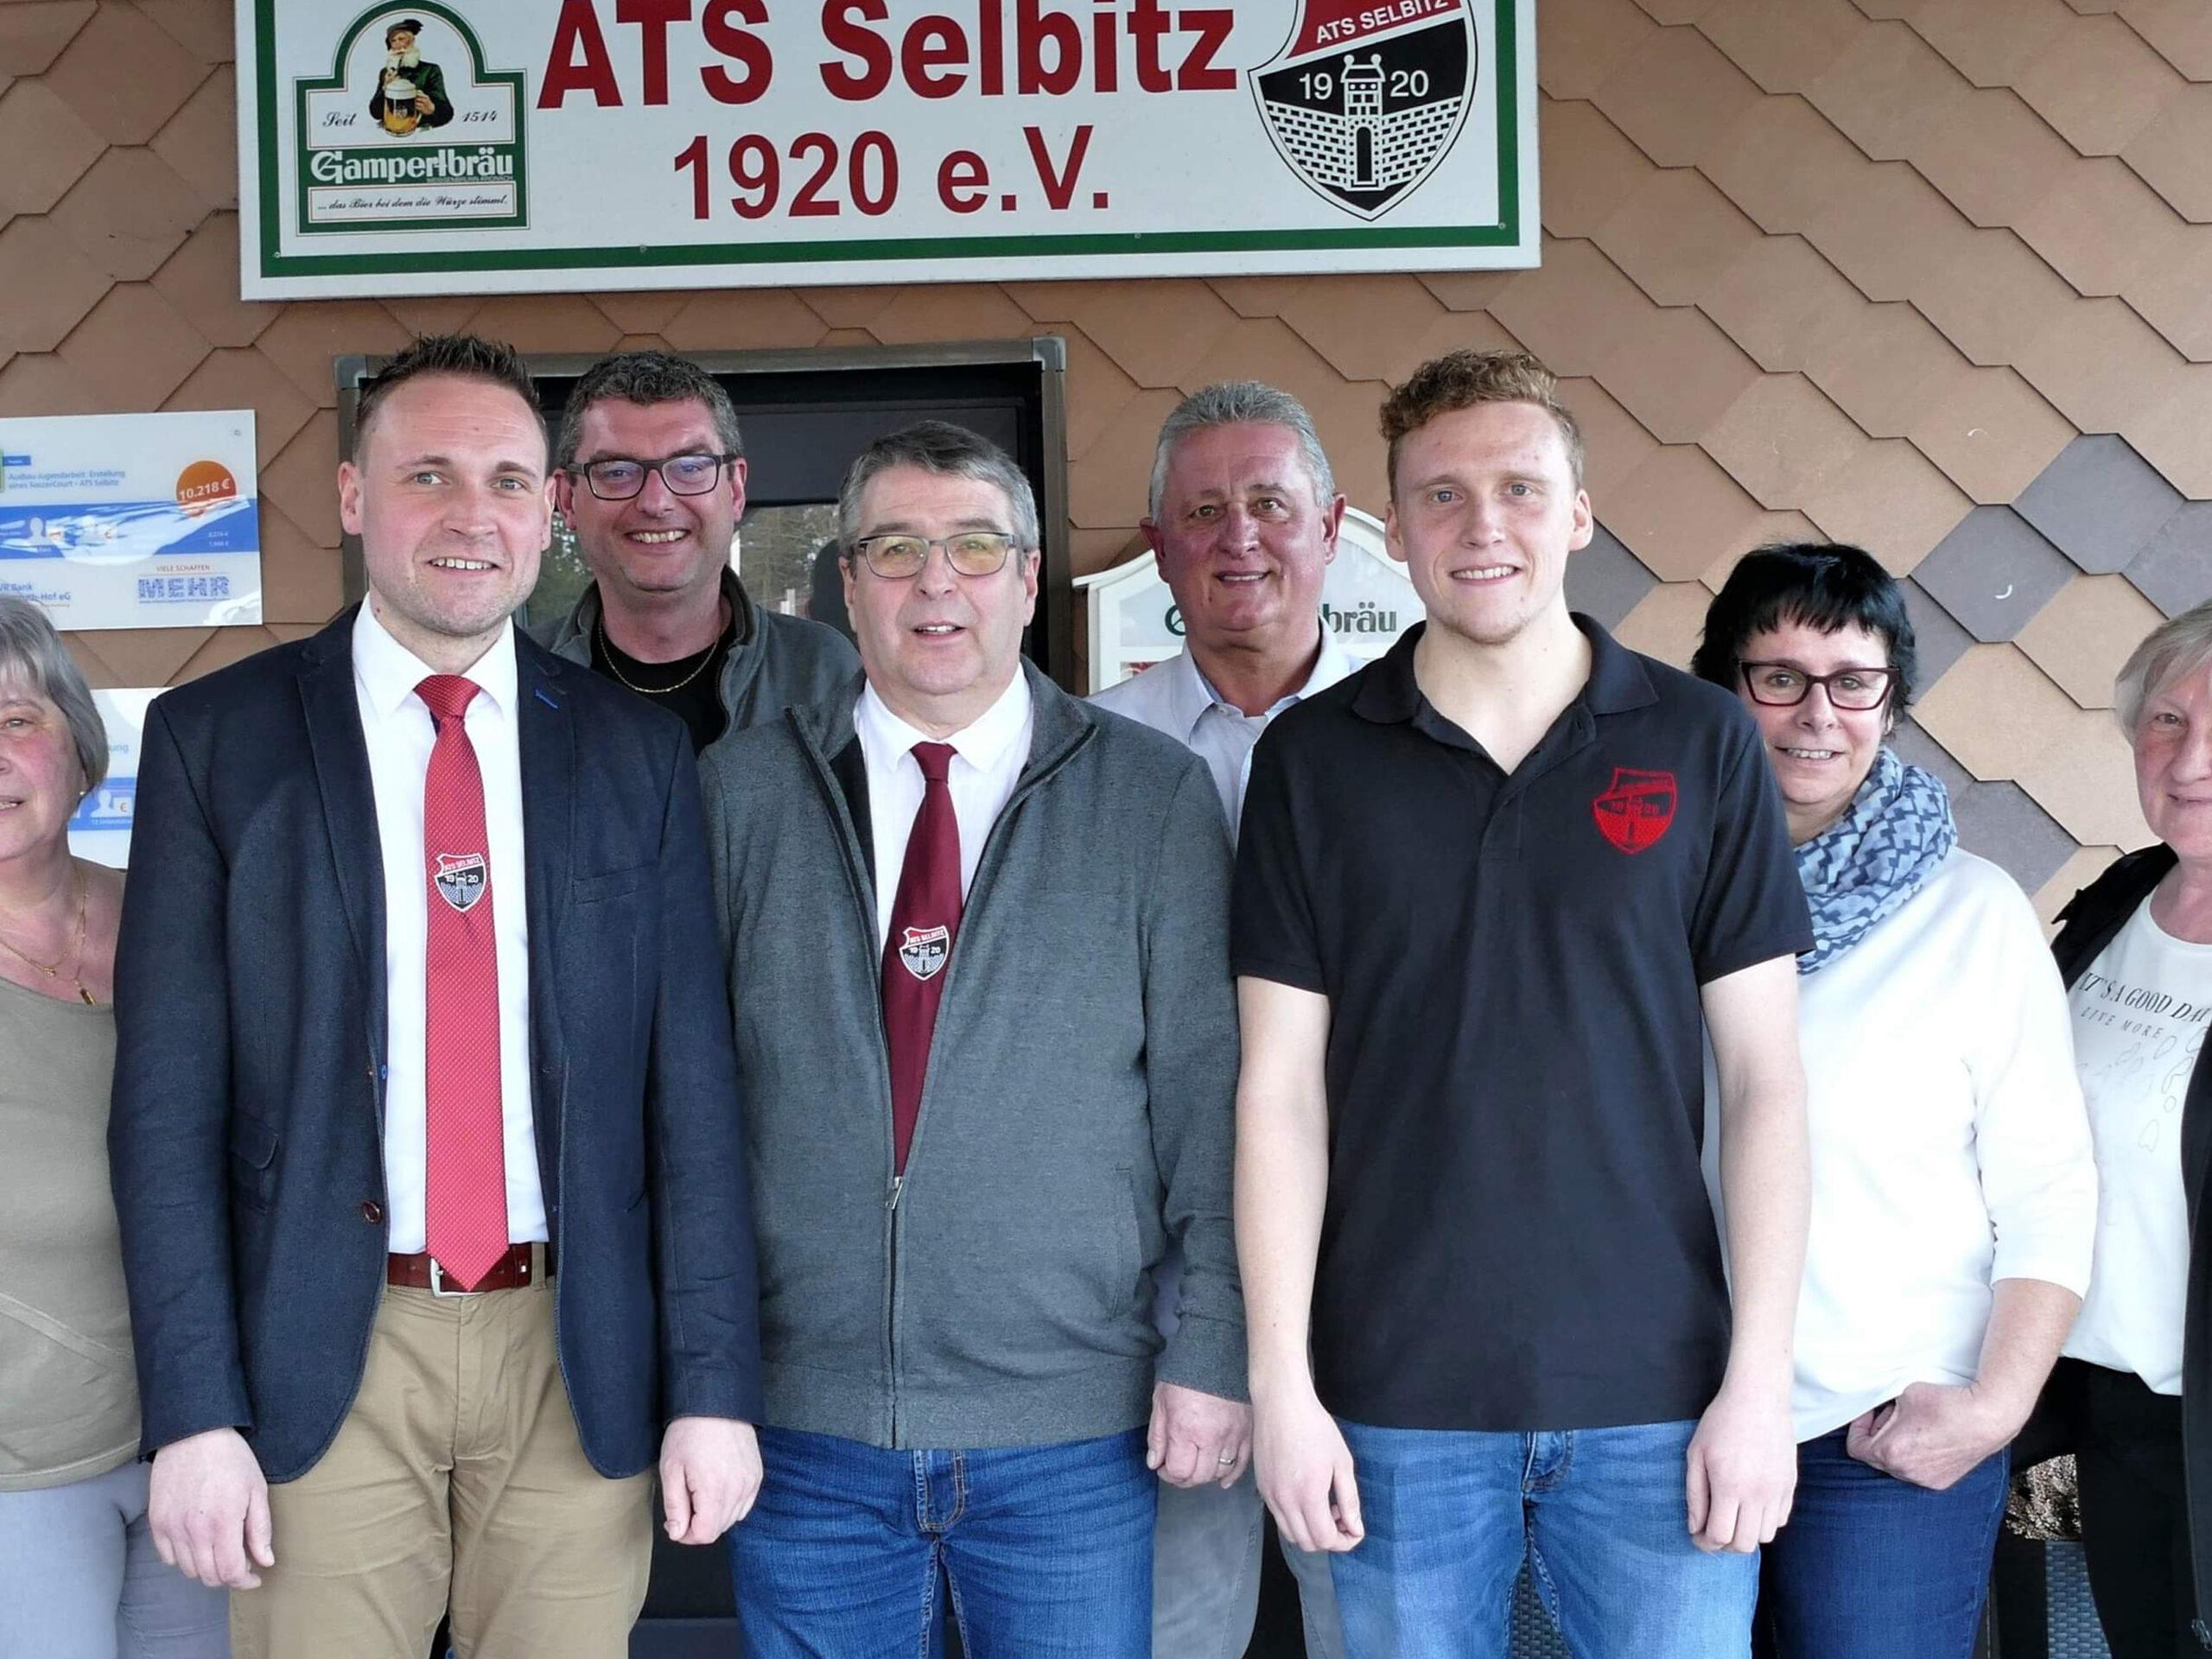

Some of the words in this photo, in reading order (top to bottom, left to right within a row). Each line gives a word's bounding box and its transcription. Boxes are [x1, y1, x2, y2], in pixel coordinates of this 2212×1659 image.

[1316, 17, 1356, 44] ATS
[537, 0, 774, 109] ATS
[818, 0, 1238, 102] Selbitz
[1299, 73, 1333, 100] 19
[1389, 69, 1430, 98] 20
[322, 111, 357, 128] Seit
[461, 109, 499, 123] 1514
[674, 130, 899, 220] 1920
[937, 124, 1109, 214] e.V.
[180, 481, 219, 500] 10.218
[221, 478, 231, 490] €
[467, 874, 480, 883] 20
[2124, 988, 2172, 1014] GOOD
